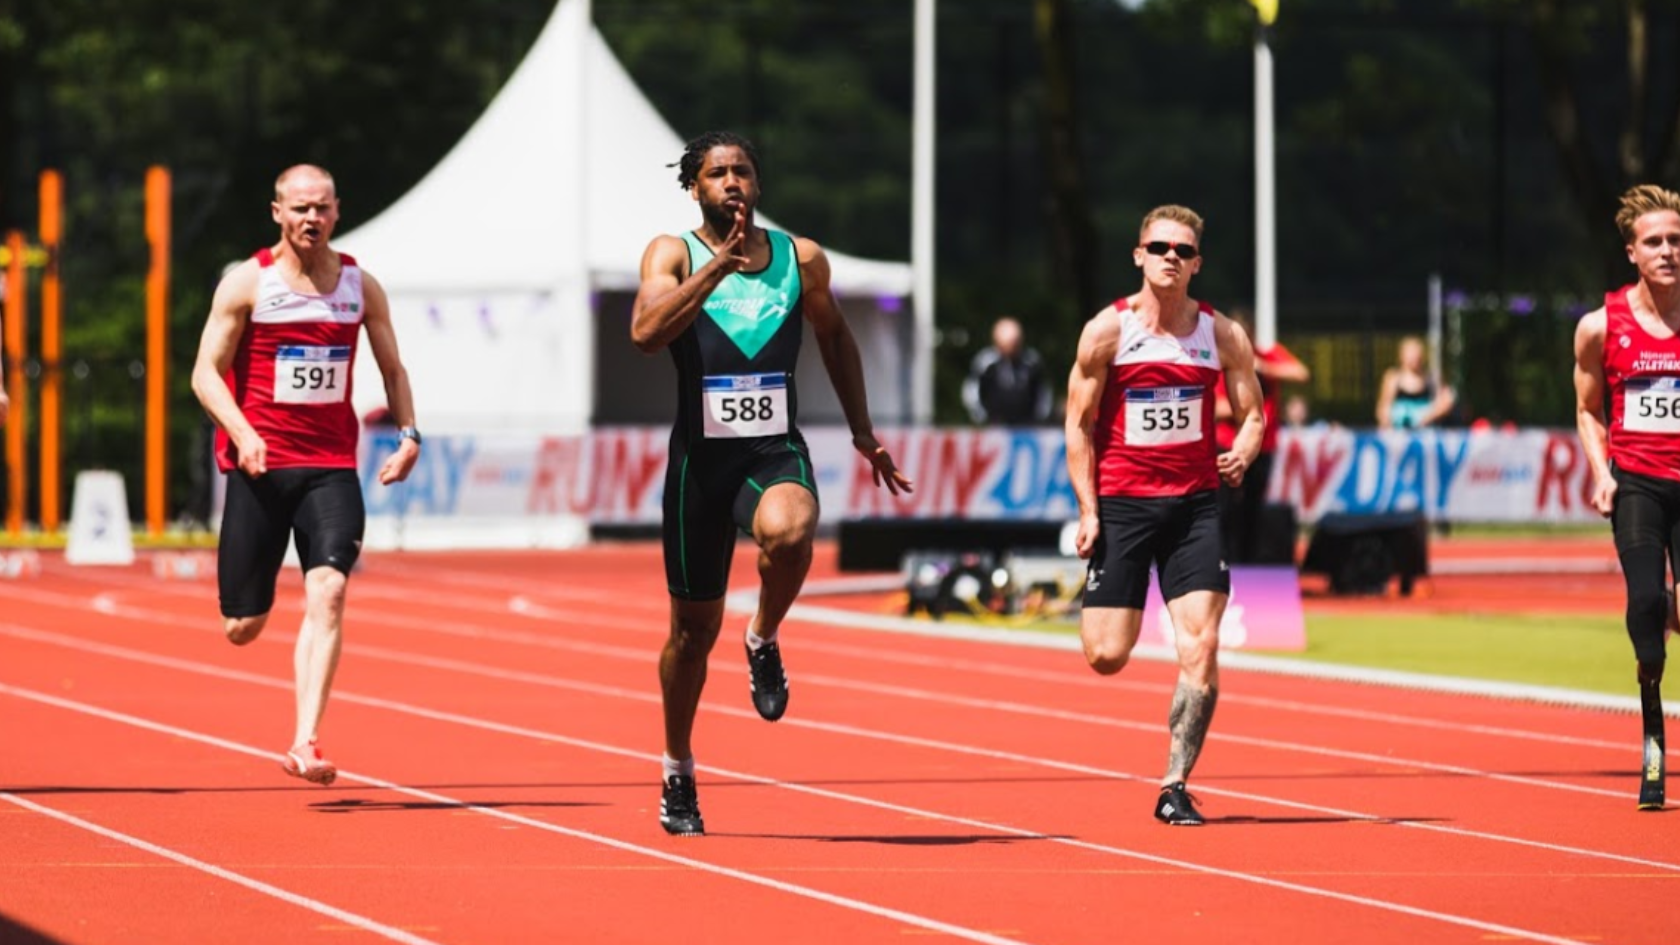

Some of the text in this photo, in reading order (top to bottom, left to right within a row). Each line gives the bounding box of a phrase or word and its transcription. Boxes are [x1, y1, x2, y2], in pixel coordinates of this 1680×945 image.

[292, 366, 336, 390] 591
[721, 396, 774, 422] 588
[1142, 406, 1190, 431] 535
[1639, 396, 1680, 419] 556
